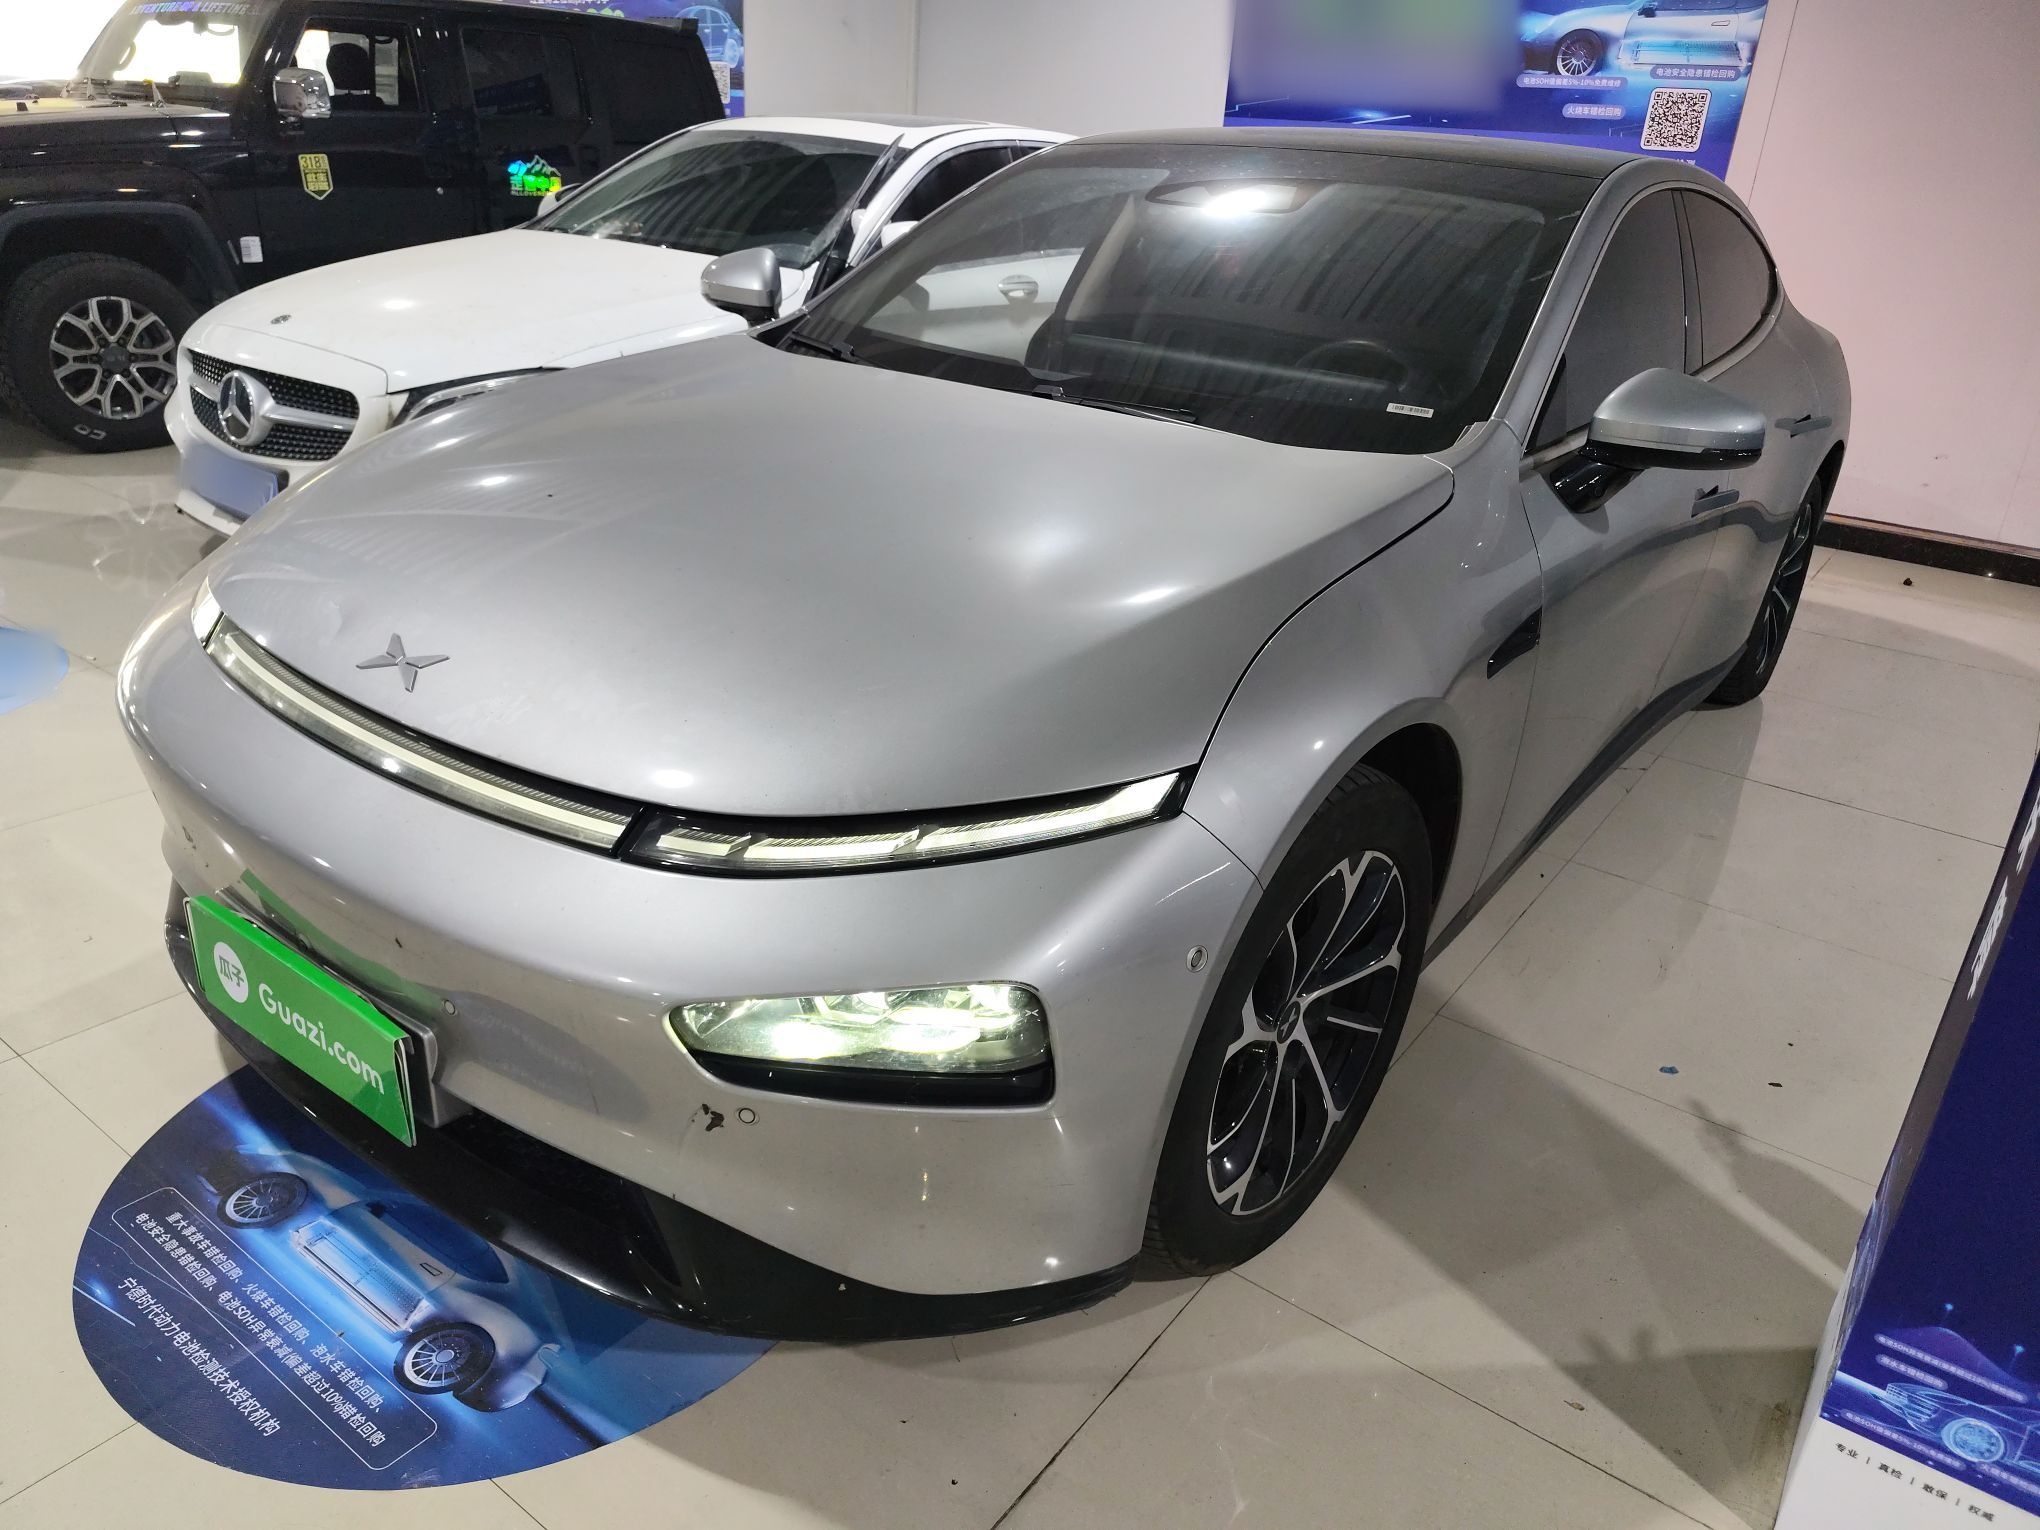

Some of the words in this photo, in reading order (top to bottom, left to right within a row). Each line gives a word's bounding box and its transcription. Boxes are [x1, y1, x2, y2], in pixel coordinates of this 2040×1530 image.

[200, 2, 250, 15] LIFETIME
[218, 954, 245, 988] 瓜子
[258, 983, 385, 1095] Guazi.com
[118, 1277, 281, 1437] 宁德时代动力电池检测技术授权机构
[1835, 1442, 1859, 1459] 专业
